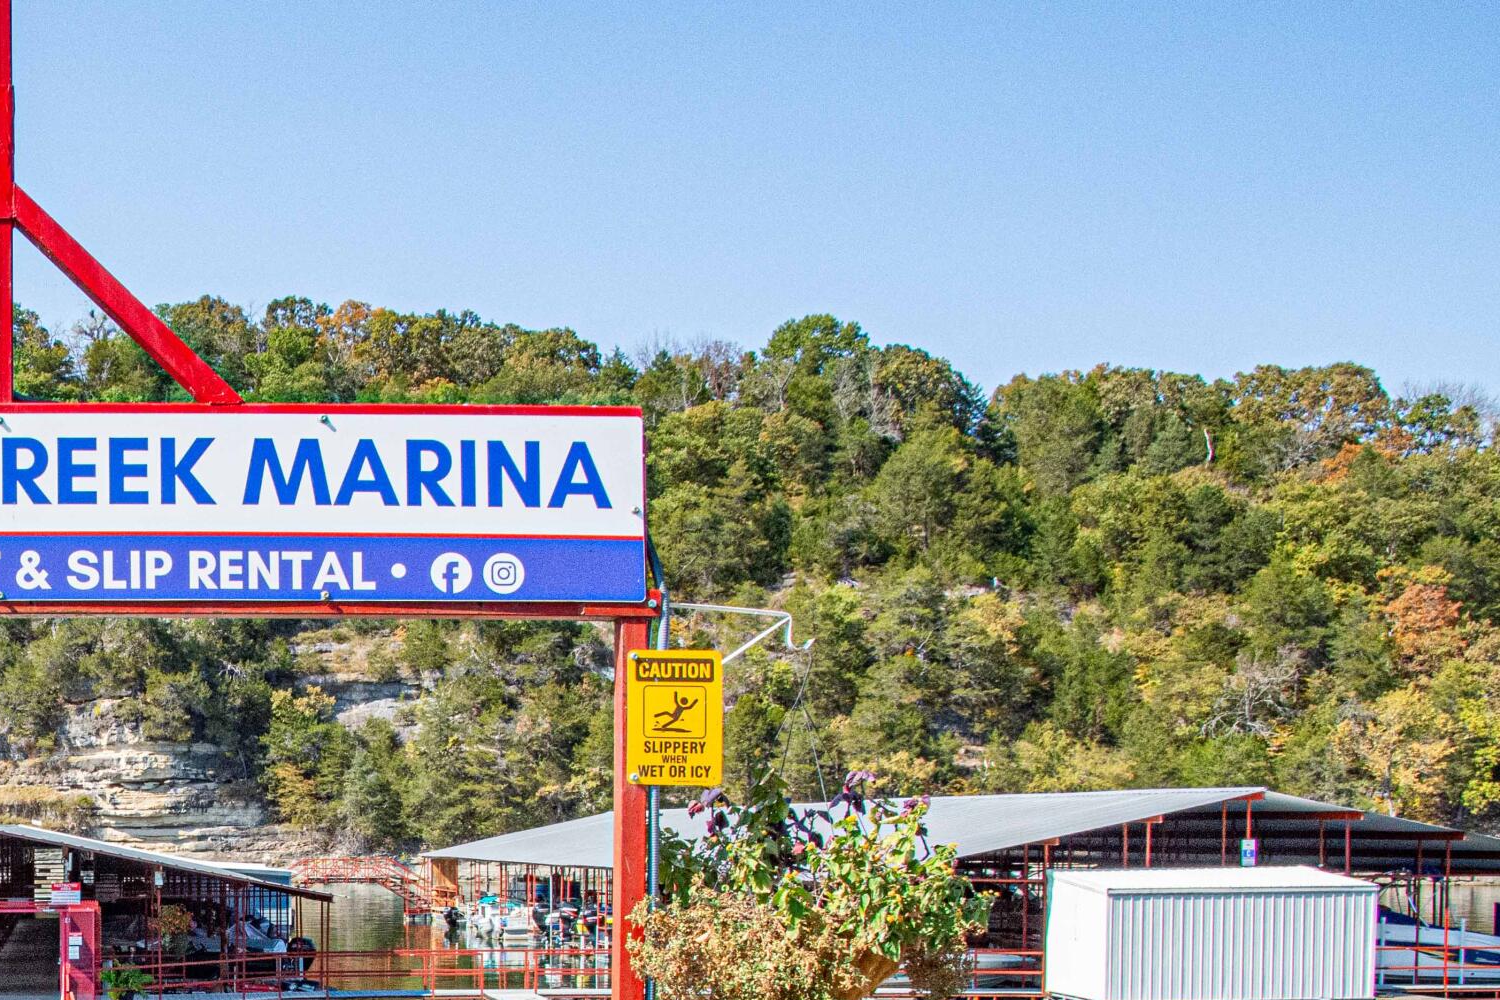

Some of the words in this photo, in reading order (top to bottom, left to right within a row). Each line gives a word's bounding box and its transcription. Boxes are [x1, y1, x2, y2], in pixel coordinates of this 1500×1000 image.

[242, 437, 613, 508] MARINA
[15, 550, 52, 590] &
[66, 550, 173, 591] SLIP
[188, 550, 377, 591] RENTAL
[638, 662, 711, 679] CAUTION
[643, 740, 706, 754] SLIPPERY
[661, 754, 688, 764] WHEN
[637, 764, 665, 778] WET
[669, 765, 686, 778] OR
[690, 765, 712, 778] ICY
